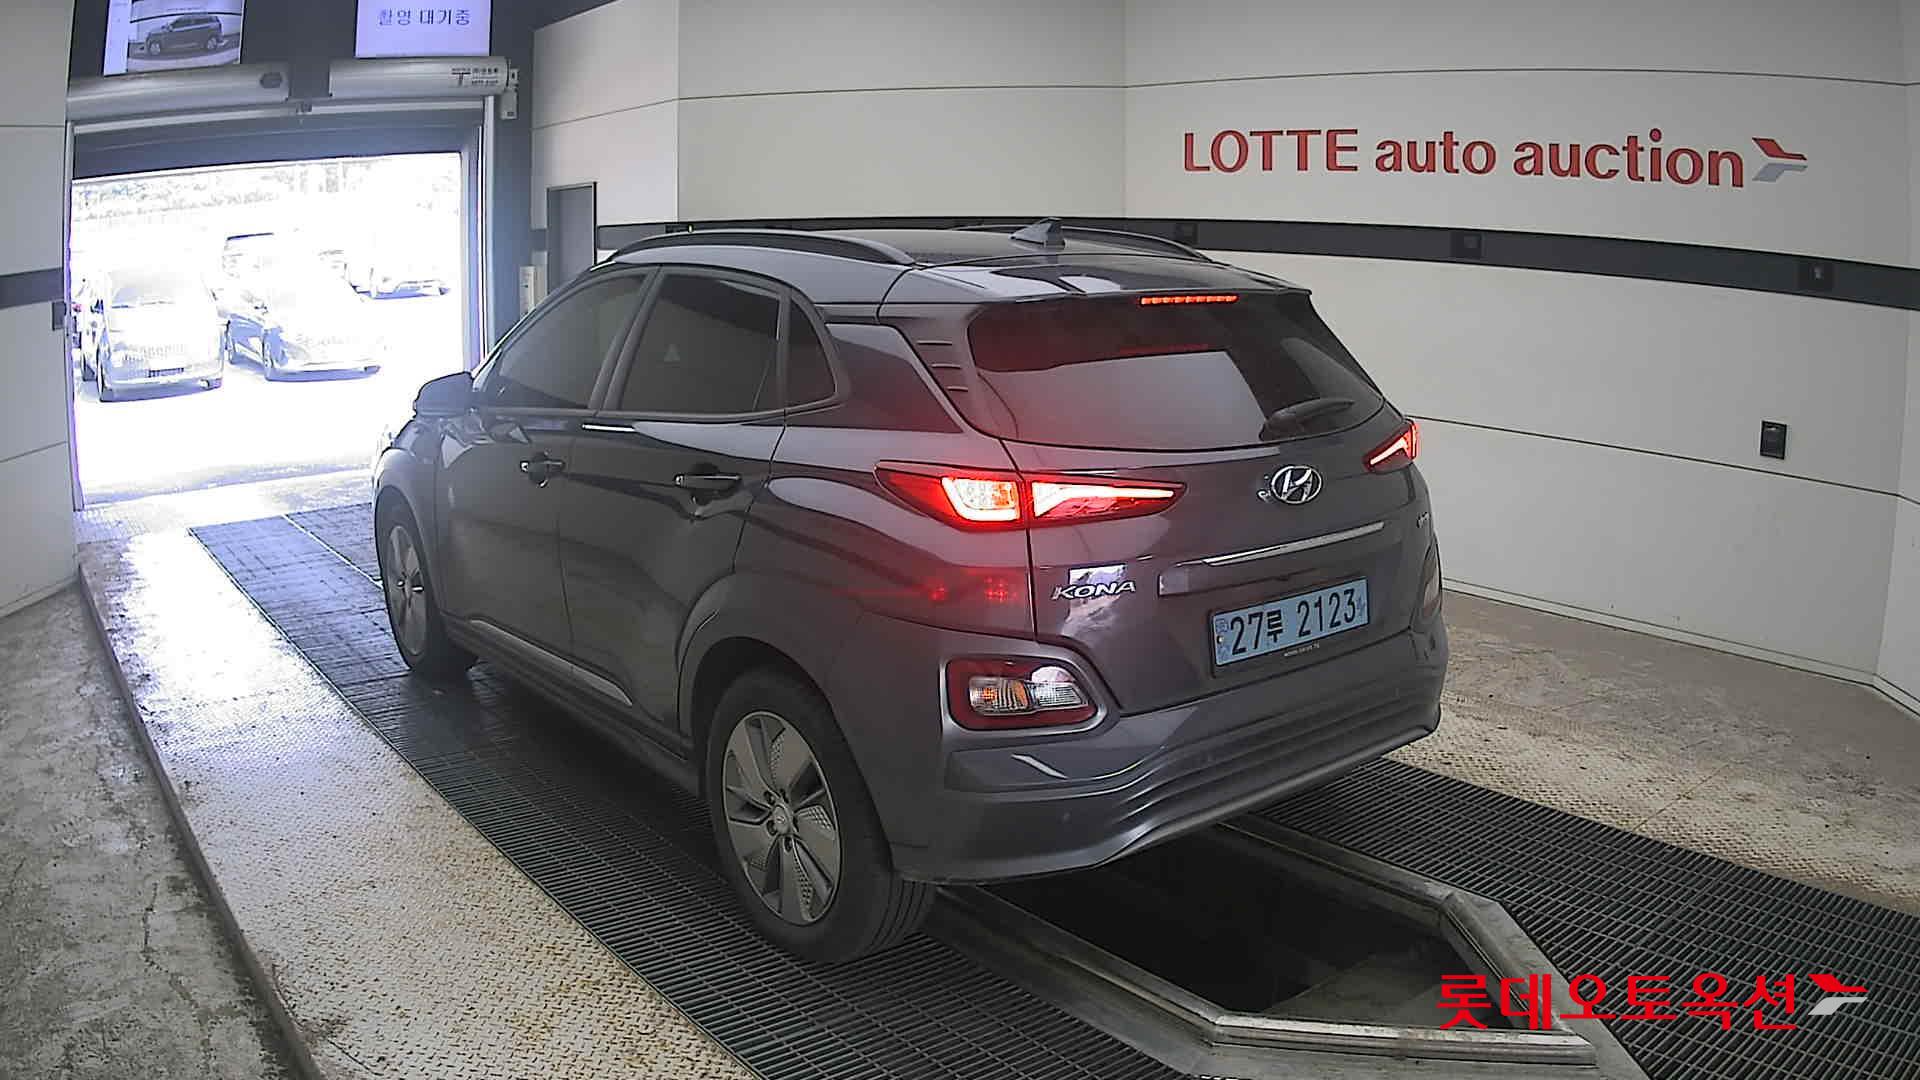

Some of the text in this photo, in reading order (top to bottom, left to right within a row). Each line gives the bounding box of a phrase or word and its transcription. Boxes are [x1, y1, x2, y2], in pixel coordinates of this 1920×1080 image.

[419, 8, 471, 26] 대기중
[1184, 128, 1744, 188] LOTTE auto auction
[1051, 580, 1136, 600] KONA
[1230, 609, 1283, 655] 27루
[1297, 588, 1356, 638] 2123
